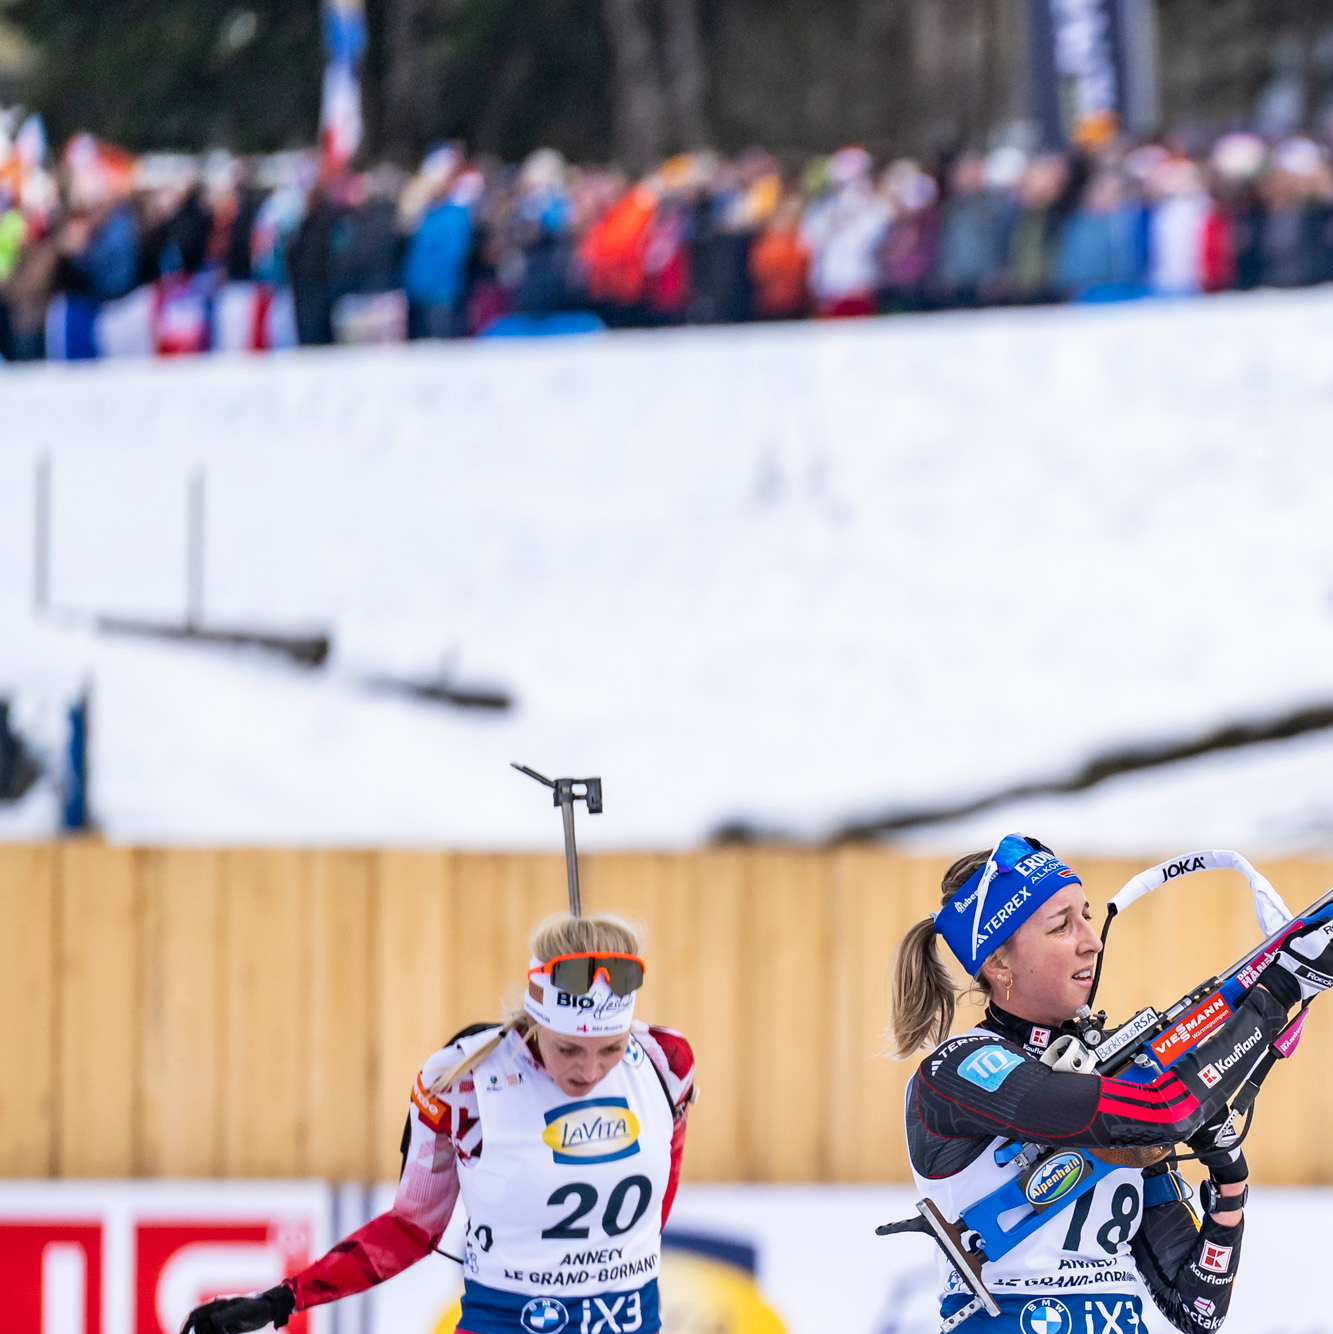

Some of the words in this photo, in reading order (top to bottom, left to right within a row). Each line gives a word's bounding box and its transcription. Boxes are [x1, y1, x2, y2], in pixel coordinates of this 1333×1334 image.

[1161, 856, 1205, 884] JOKA
[983, 885, 1032, 935] TERREX
[1237, 965, 1254, 982] DAS
[1155, 997, 1225, 1054] VIESSMANN
[1214, 1026, 1263, 1074] Kaufland
[1030, 1156, 1080, 1199] Alpenhain
[541, 1174, 653, 1240] 20
[1062, 1183, 1140, 1255] 18
[504, 1268, 524, 1281] LE
[1189, 1262, 1235, 1285] Kaufland
[1181, 1300, 1227, 1330] ectake
